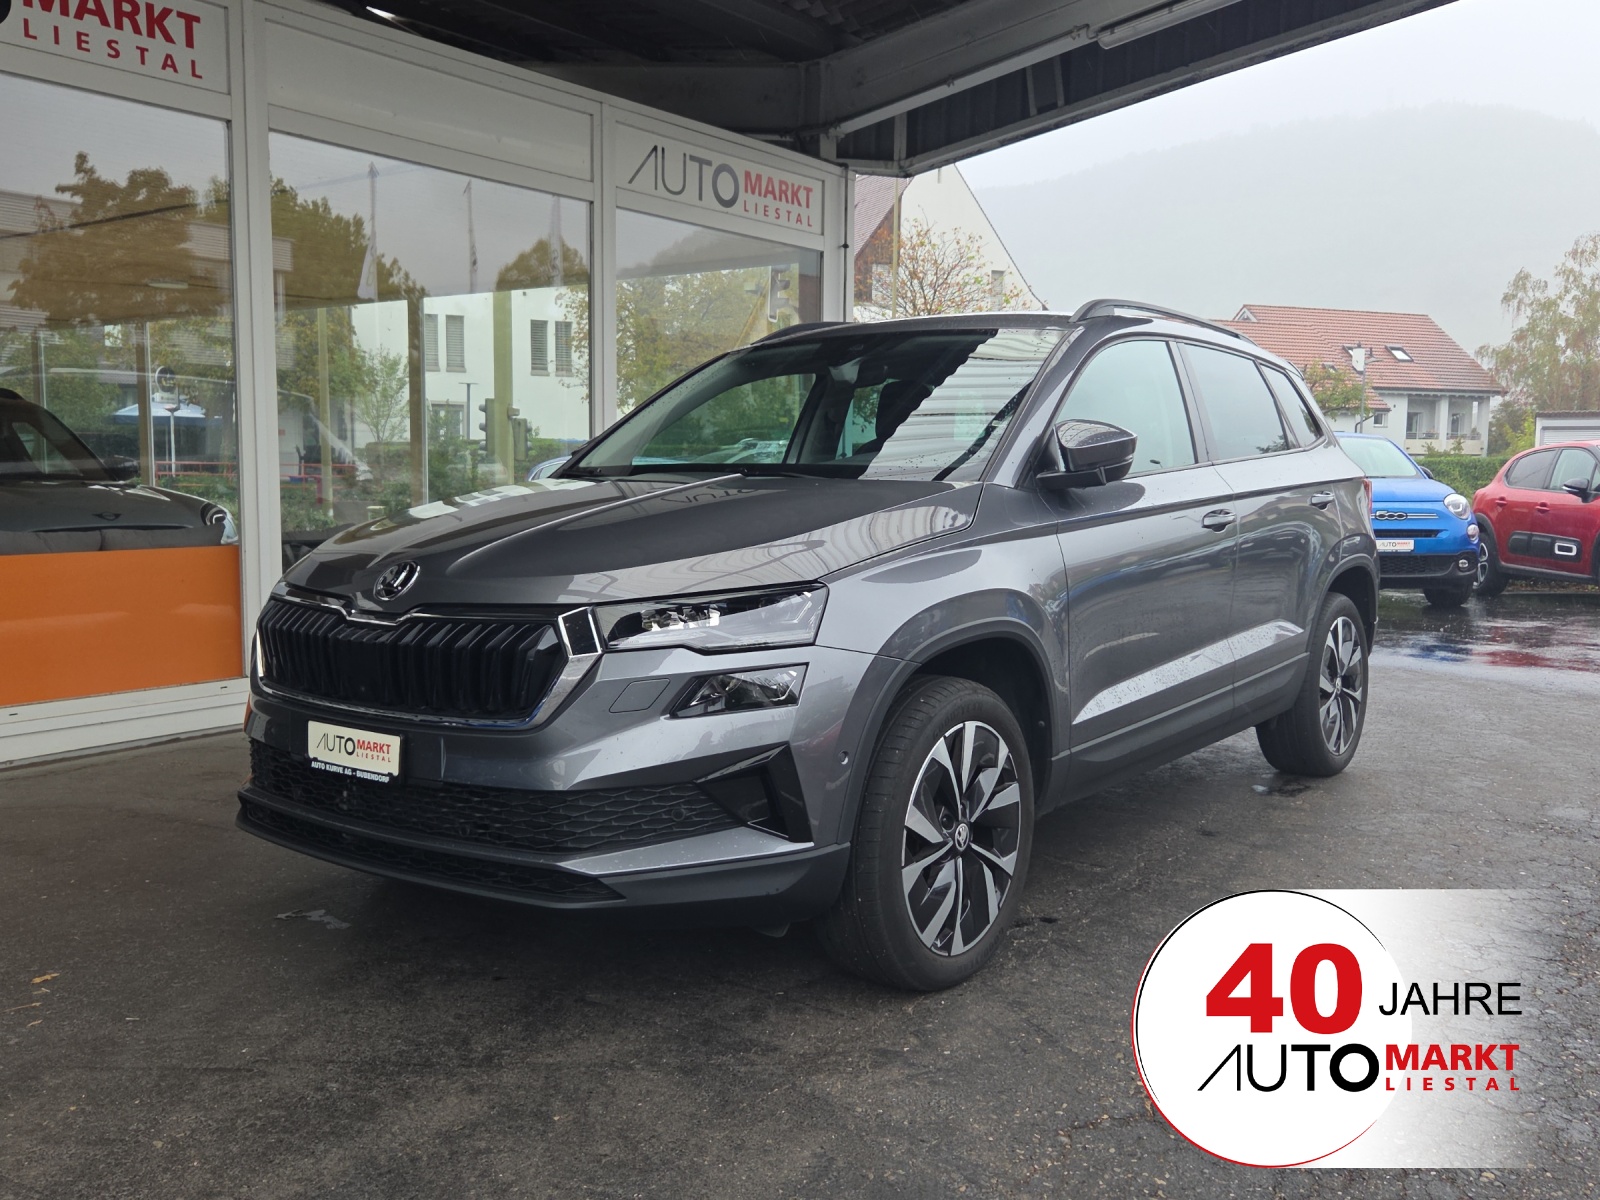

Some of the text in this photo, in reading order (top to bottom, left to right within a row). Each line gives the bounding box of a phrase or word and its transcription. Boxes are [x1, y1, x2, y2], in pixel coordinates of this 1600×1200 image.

[22, 0, 201, 49] ARKT
[23, 18, 203, 79] LIESTAL
[627, 145, 814, 209] AUTO MARKT
[743, 200, 813, 228] LIESTAL
[1375, 510, 1407, 520] 500
[317, 733, 391, 755] AUTO MARKT
[356, 751, 391, 762] LIESTAL
[311, 761, 325, 770] AUTO
[344, 767, 352, 776] AG
